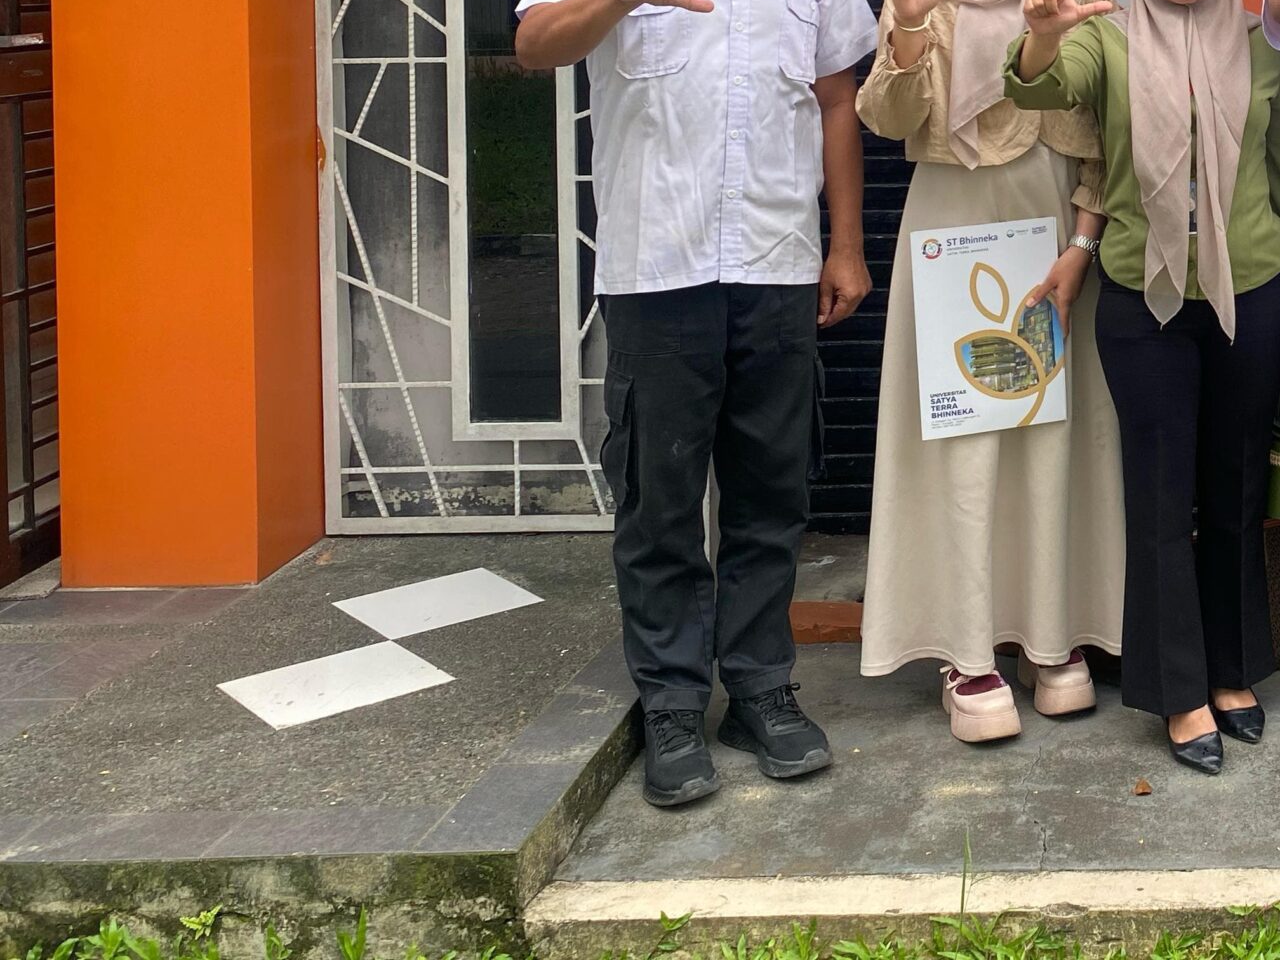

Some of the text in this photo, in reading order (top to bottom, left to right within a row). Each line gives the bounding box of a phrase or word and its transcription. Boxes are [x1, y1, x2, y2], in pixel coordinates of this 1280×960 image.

[946, 233, 999, 247] ST Bhinneka
[930, 389, 967, 398] UNIVERSITAS
[930, 396, 957, 405] SATYA
[931, 403, 958, 412] TERRA
[931, 408, 974, 419] BHINNEKA
